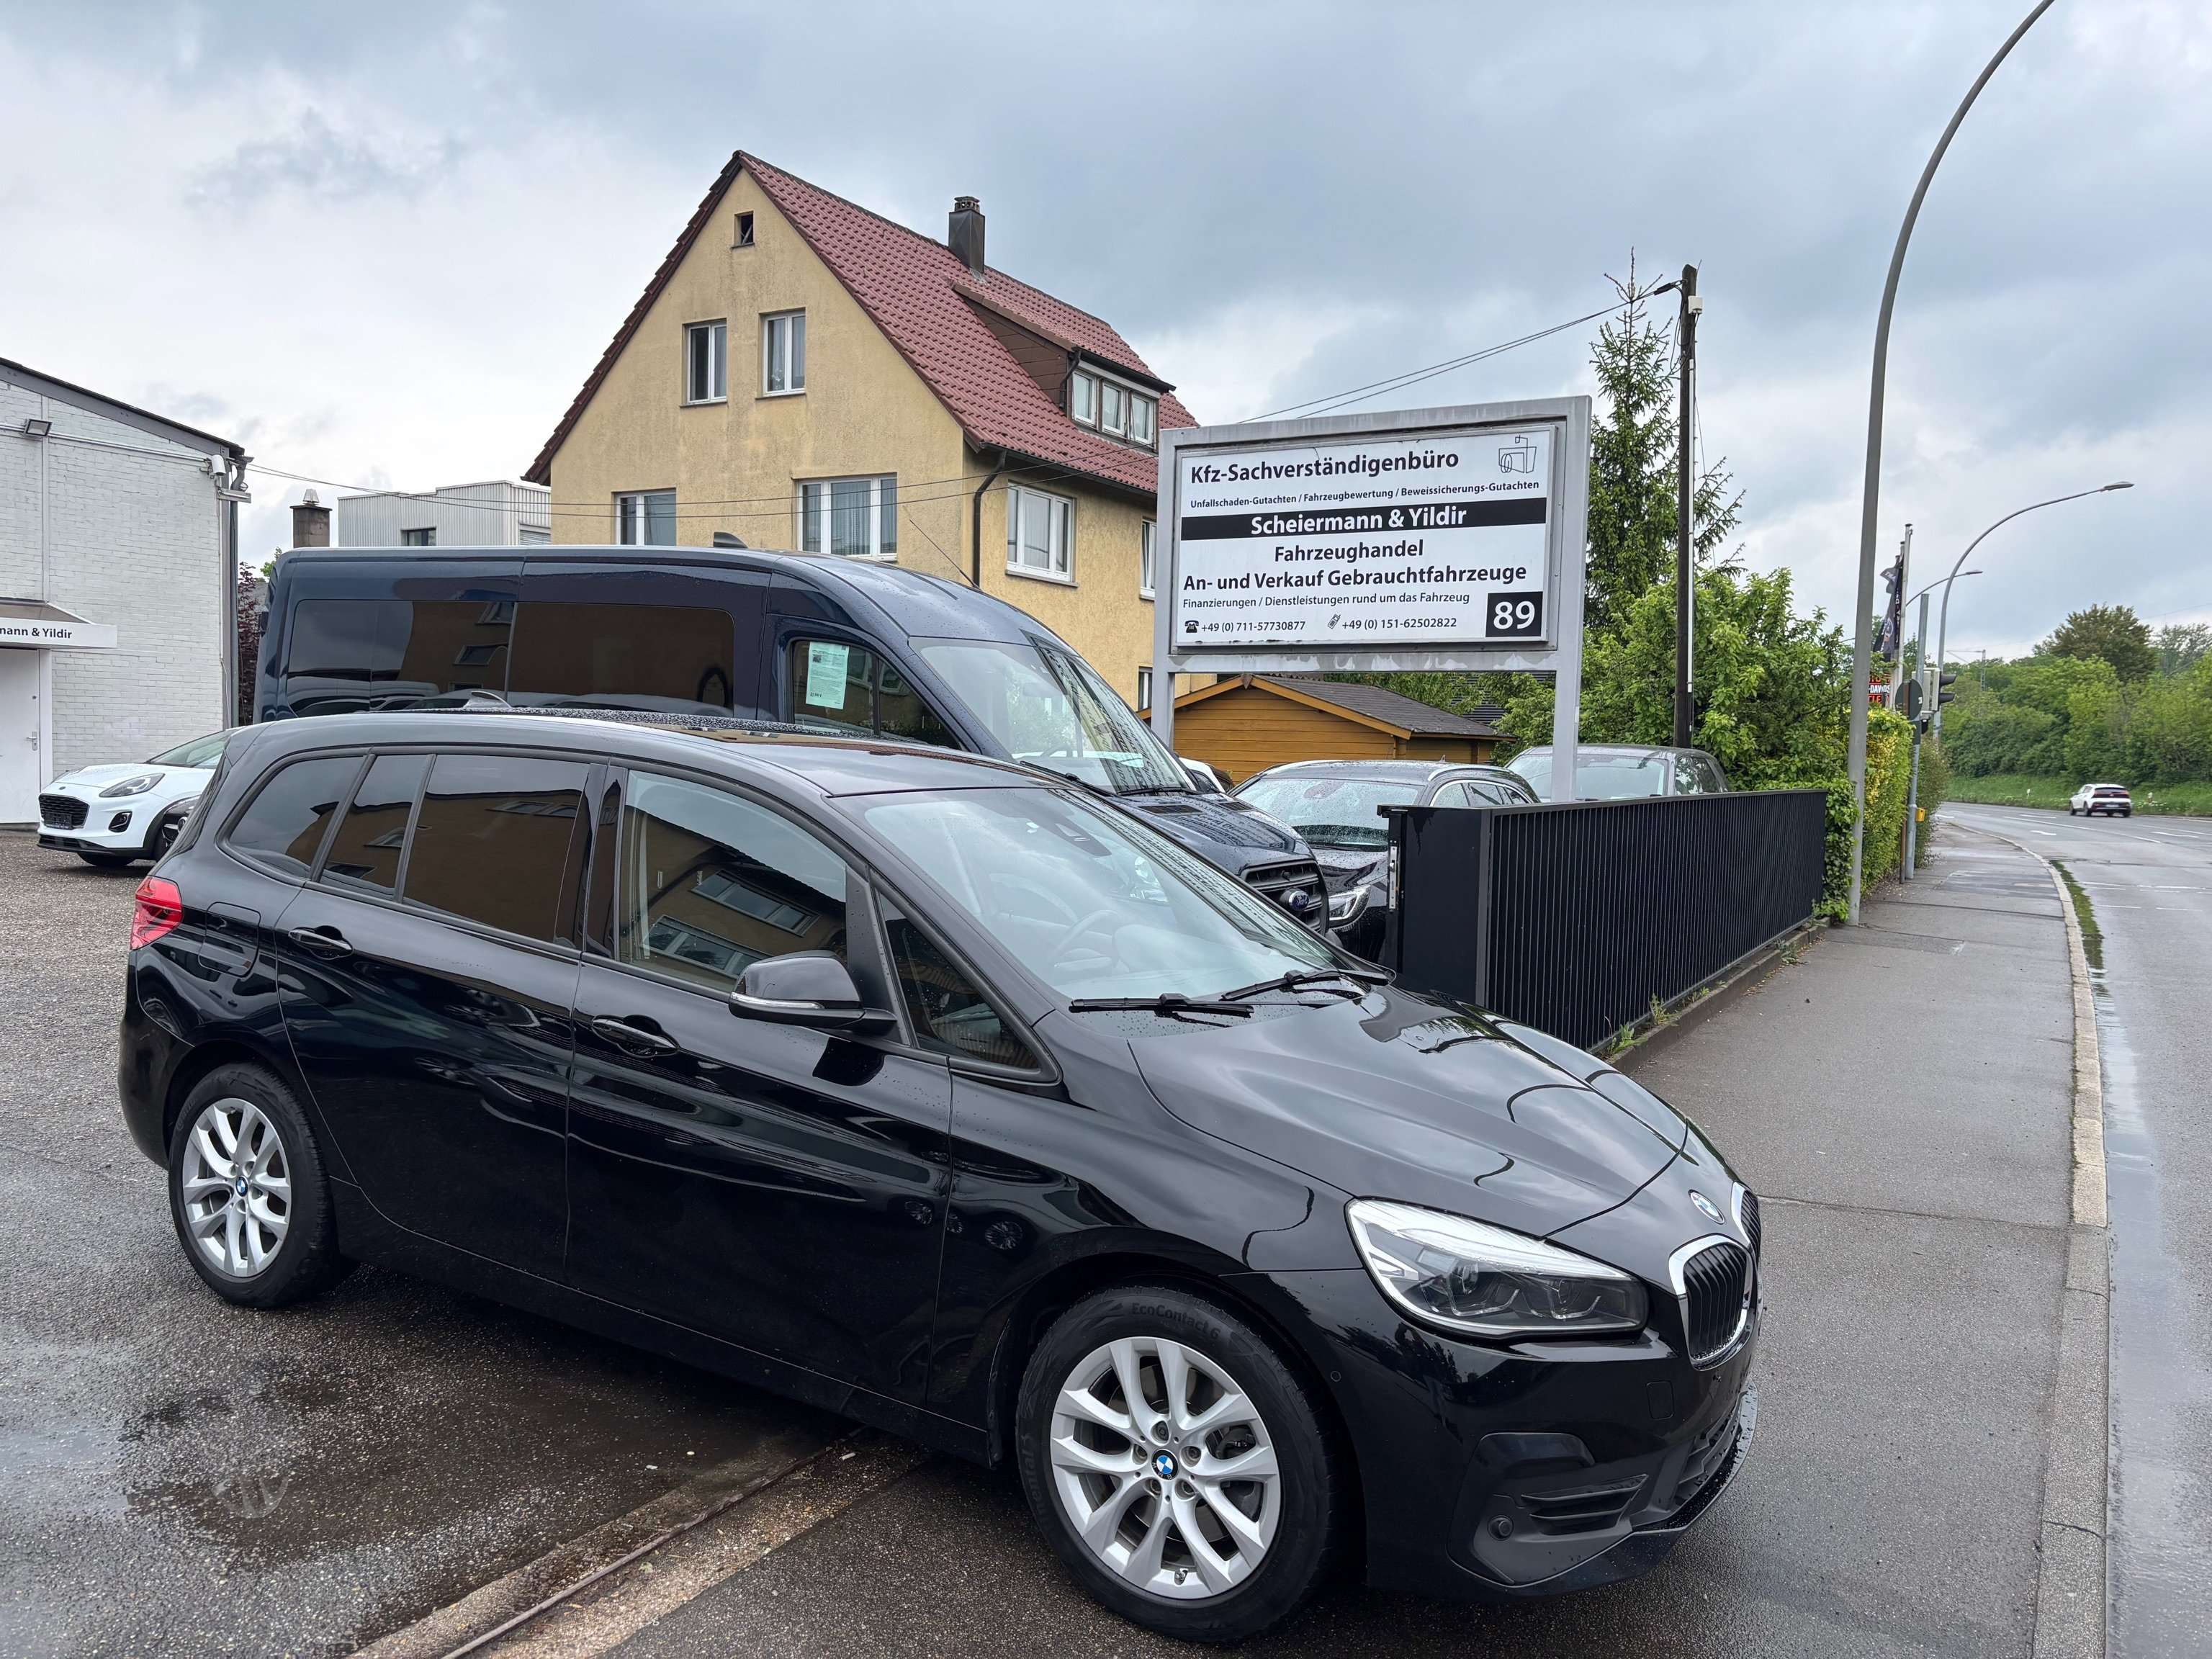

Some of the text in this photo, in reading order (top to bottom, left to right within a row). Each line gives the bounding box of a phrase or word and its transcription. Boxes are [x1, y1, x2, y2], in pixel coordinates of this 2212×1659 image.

[1191, 450, 1459, 484] Kfz-Sachverständigenbüro
[1190, 480, 1539, 508] Unfallschaden-Gutachten / Fahrzeugbewertung / Beweissicherungs-Gutachten
[1251, 506, 1467, 535] Scheiermann & Yildir
[1274, 539, 1424, 564] Fahrzeughandel
[1183, 565, 1527, 590] An- und Verkauf Gebrauchtfahrzeuge
[1183, 598, 1256, 609] Finanzierungen
[1258, 597, 1263, 606] /
[1265, 595, 1349, 607] Dienstleistungen
[1352, 593, 1377, 603] rund
[1398, 592, 1417, 603] das
[1420, 592, 1470, 605] Fahrzeug
[1201, 621, 1305, 633] +49 (0) 711-57730877
[1341, 617, 1457, 630] +49 (0) 151-62502822
[1493, 601, 1535, 630] 89
[32, 627, 40, 637] &
[42, 628, 72, 639] Yildir
[1131, 1302, 1221, 1339] EcoContact 6
